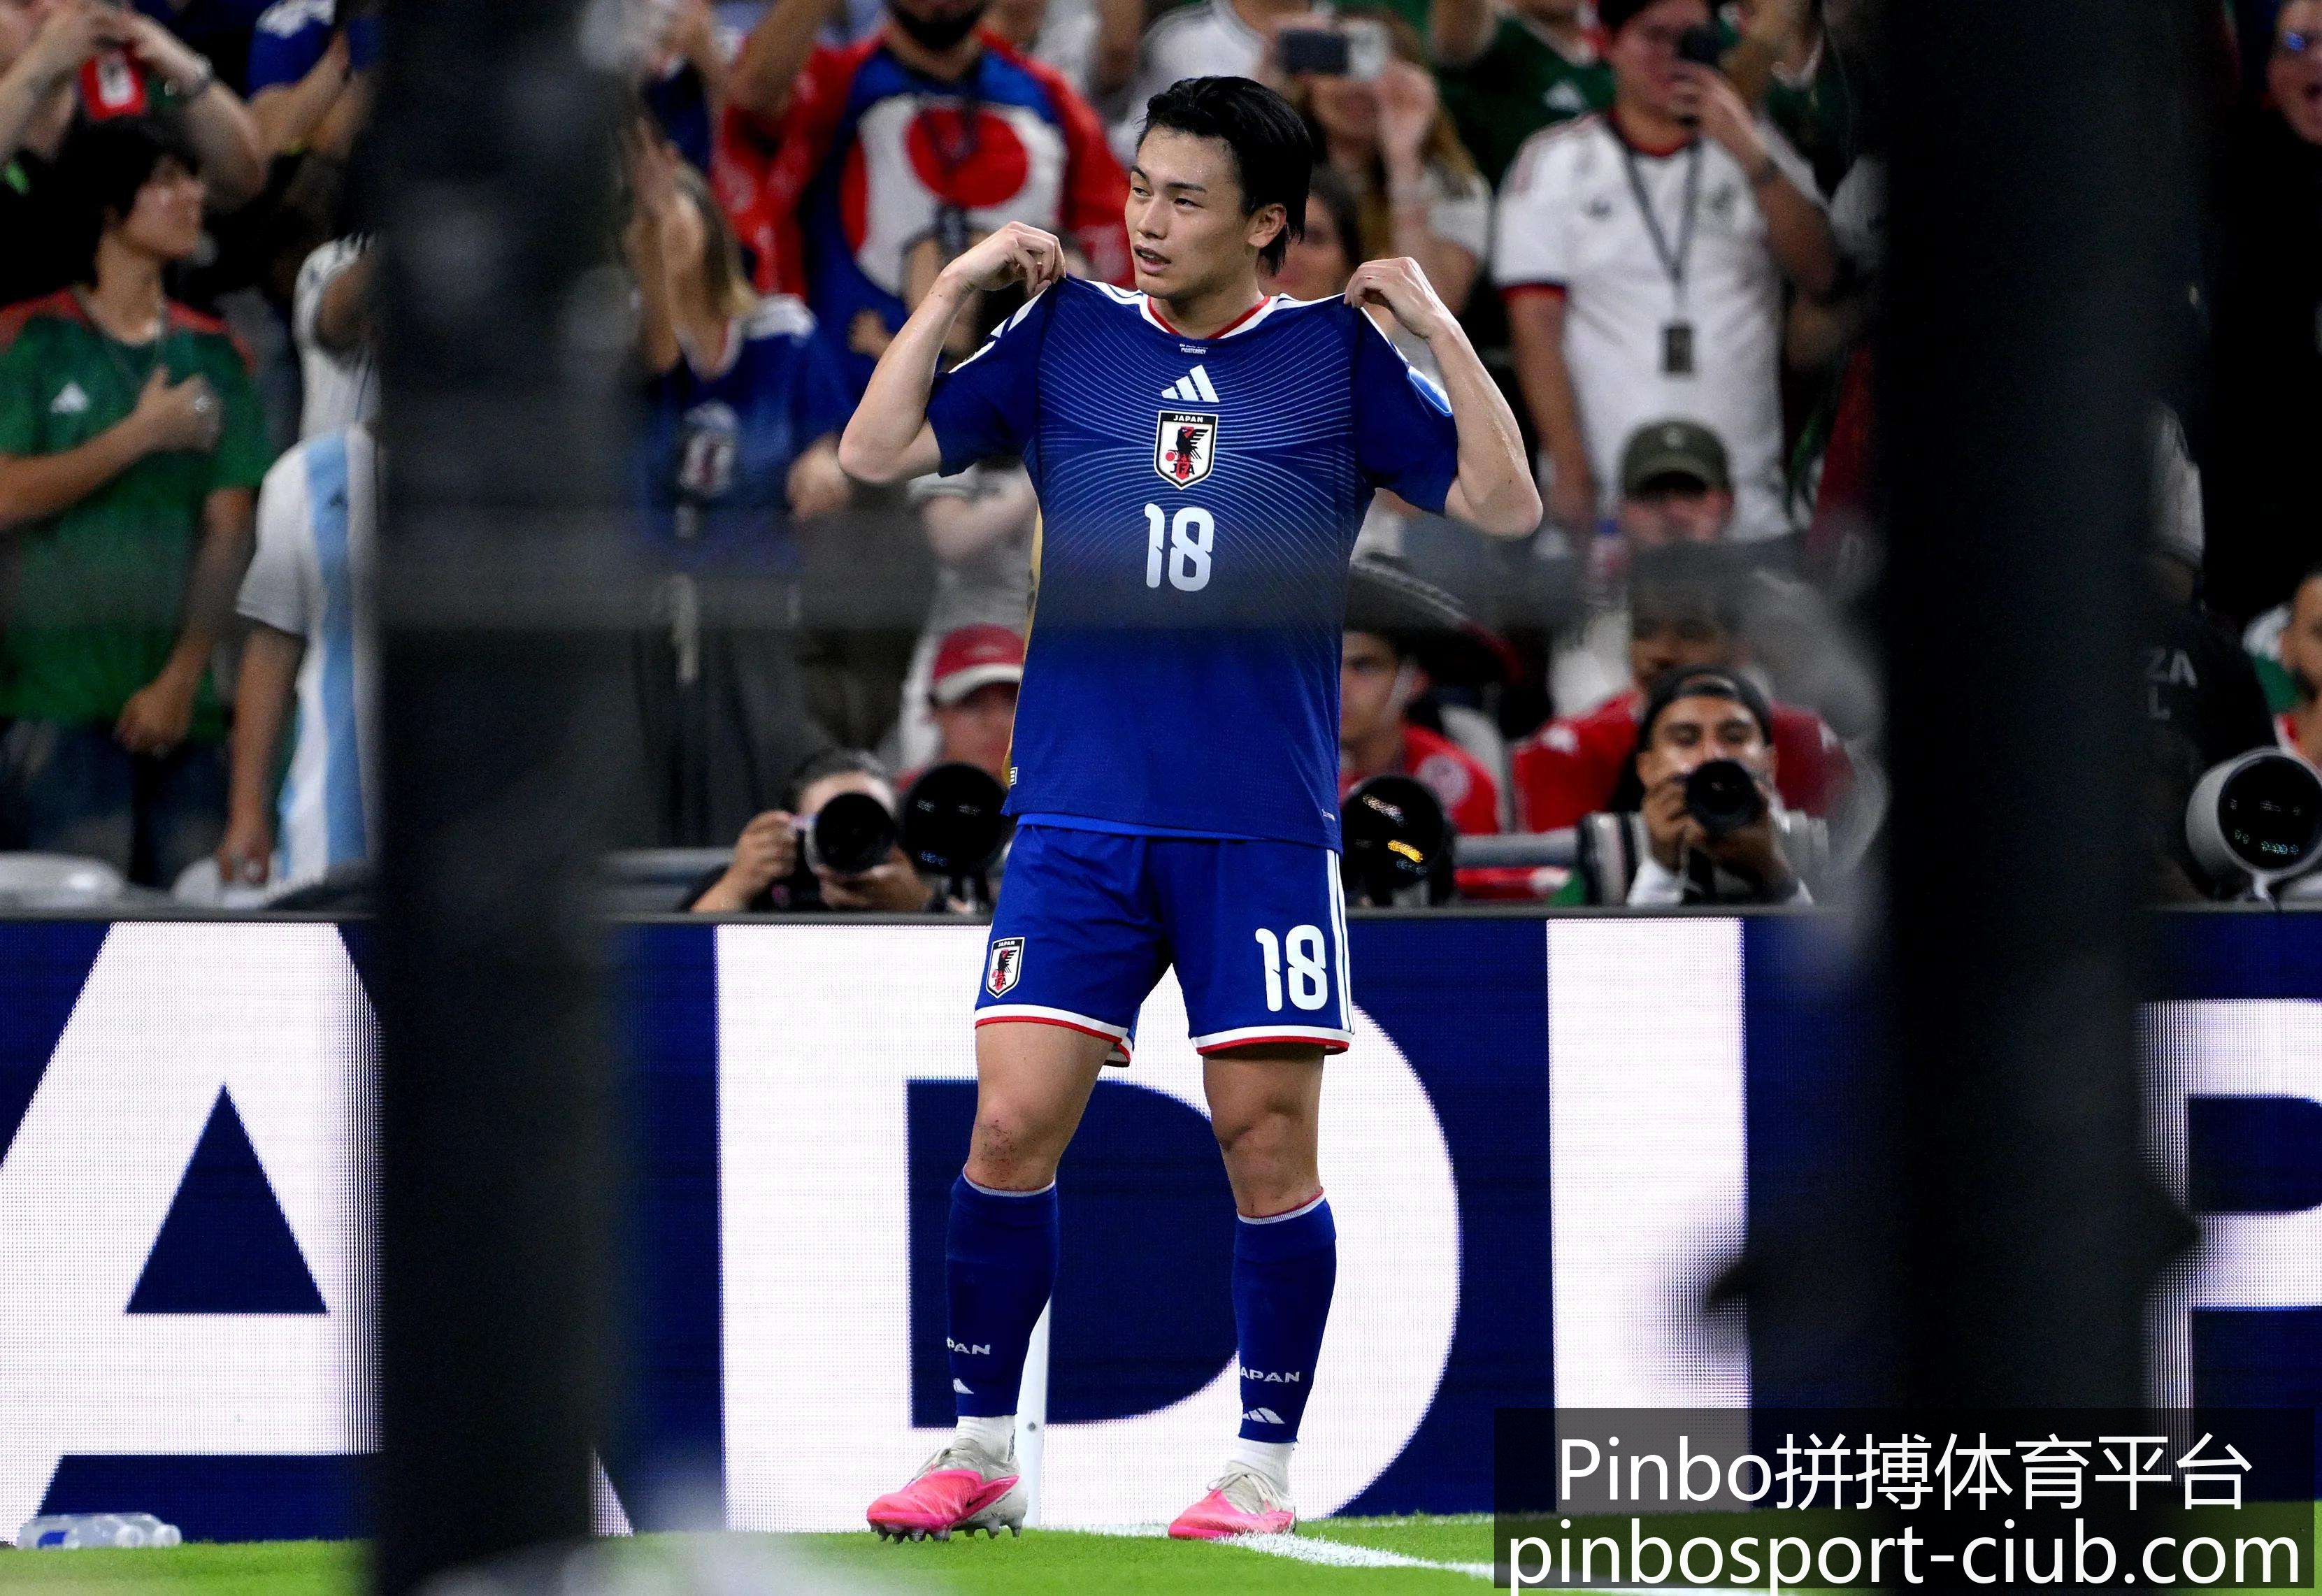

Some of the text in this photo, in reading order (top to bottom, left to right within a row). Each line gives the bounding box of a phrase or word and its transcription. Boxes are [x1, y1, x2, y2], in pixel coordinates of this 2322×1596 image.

[1173, 415, 1203, 423] JAPAN
[1170, 463, 1195, 475] JFA
[1144, 503, 1214, 592] 18
[1255, 924, 1328, 1012] 18
